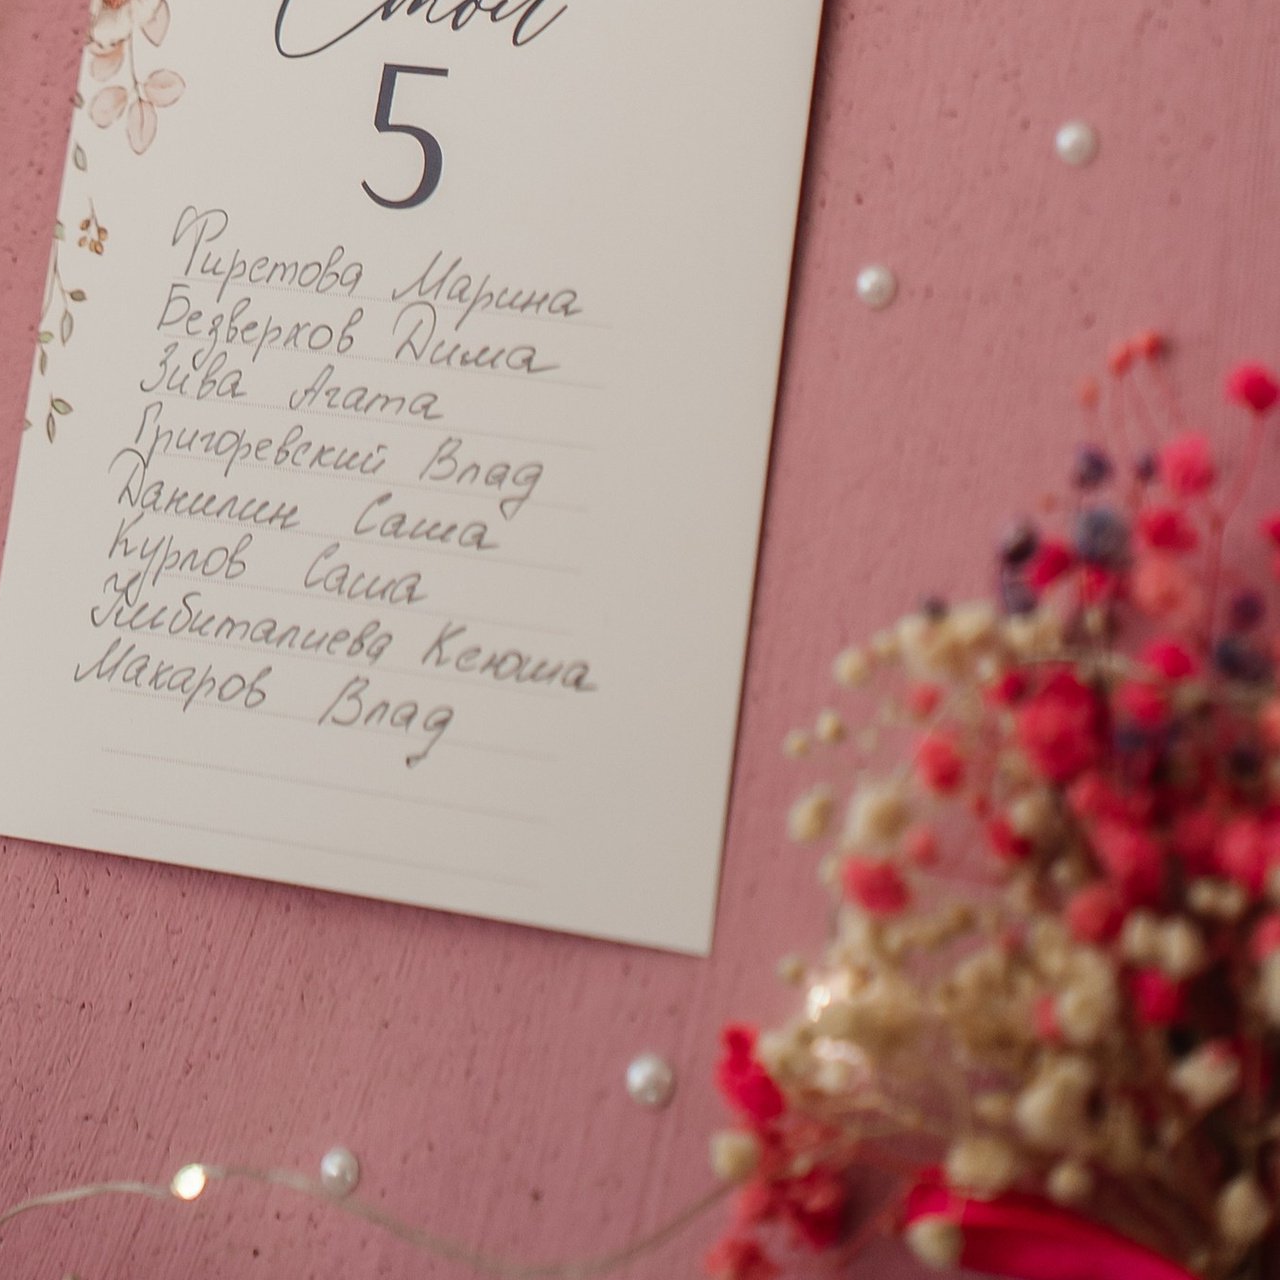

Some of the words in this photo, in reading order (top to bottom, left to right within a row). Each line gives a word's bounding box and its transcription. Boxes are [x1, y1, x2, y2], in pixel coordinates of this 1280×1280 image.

[361, 62, 449, 210] 5
[158, 282, 364, 370] Безверхов
[395, 301, 560, 374] Дима
[392, 250, 584, 331] Марина
[289, 364, 444, 420] Агата
[108, 448, 300, 532] Данилин
[354, 493, 501, 551] Саша
[135, 401, 388, 477] Григоревский
[419, 438, 544, 520] Влад
[304, 542, 428, 606] Саша
[74, 638, 272, 712] Макаров
[318, 675, 455, 768] Влад
